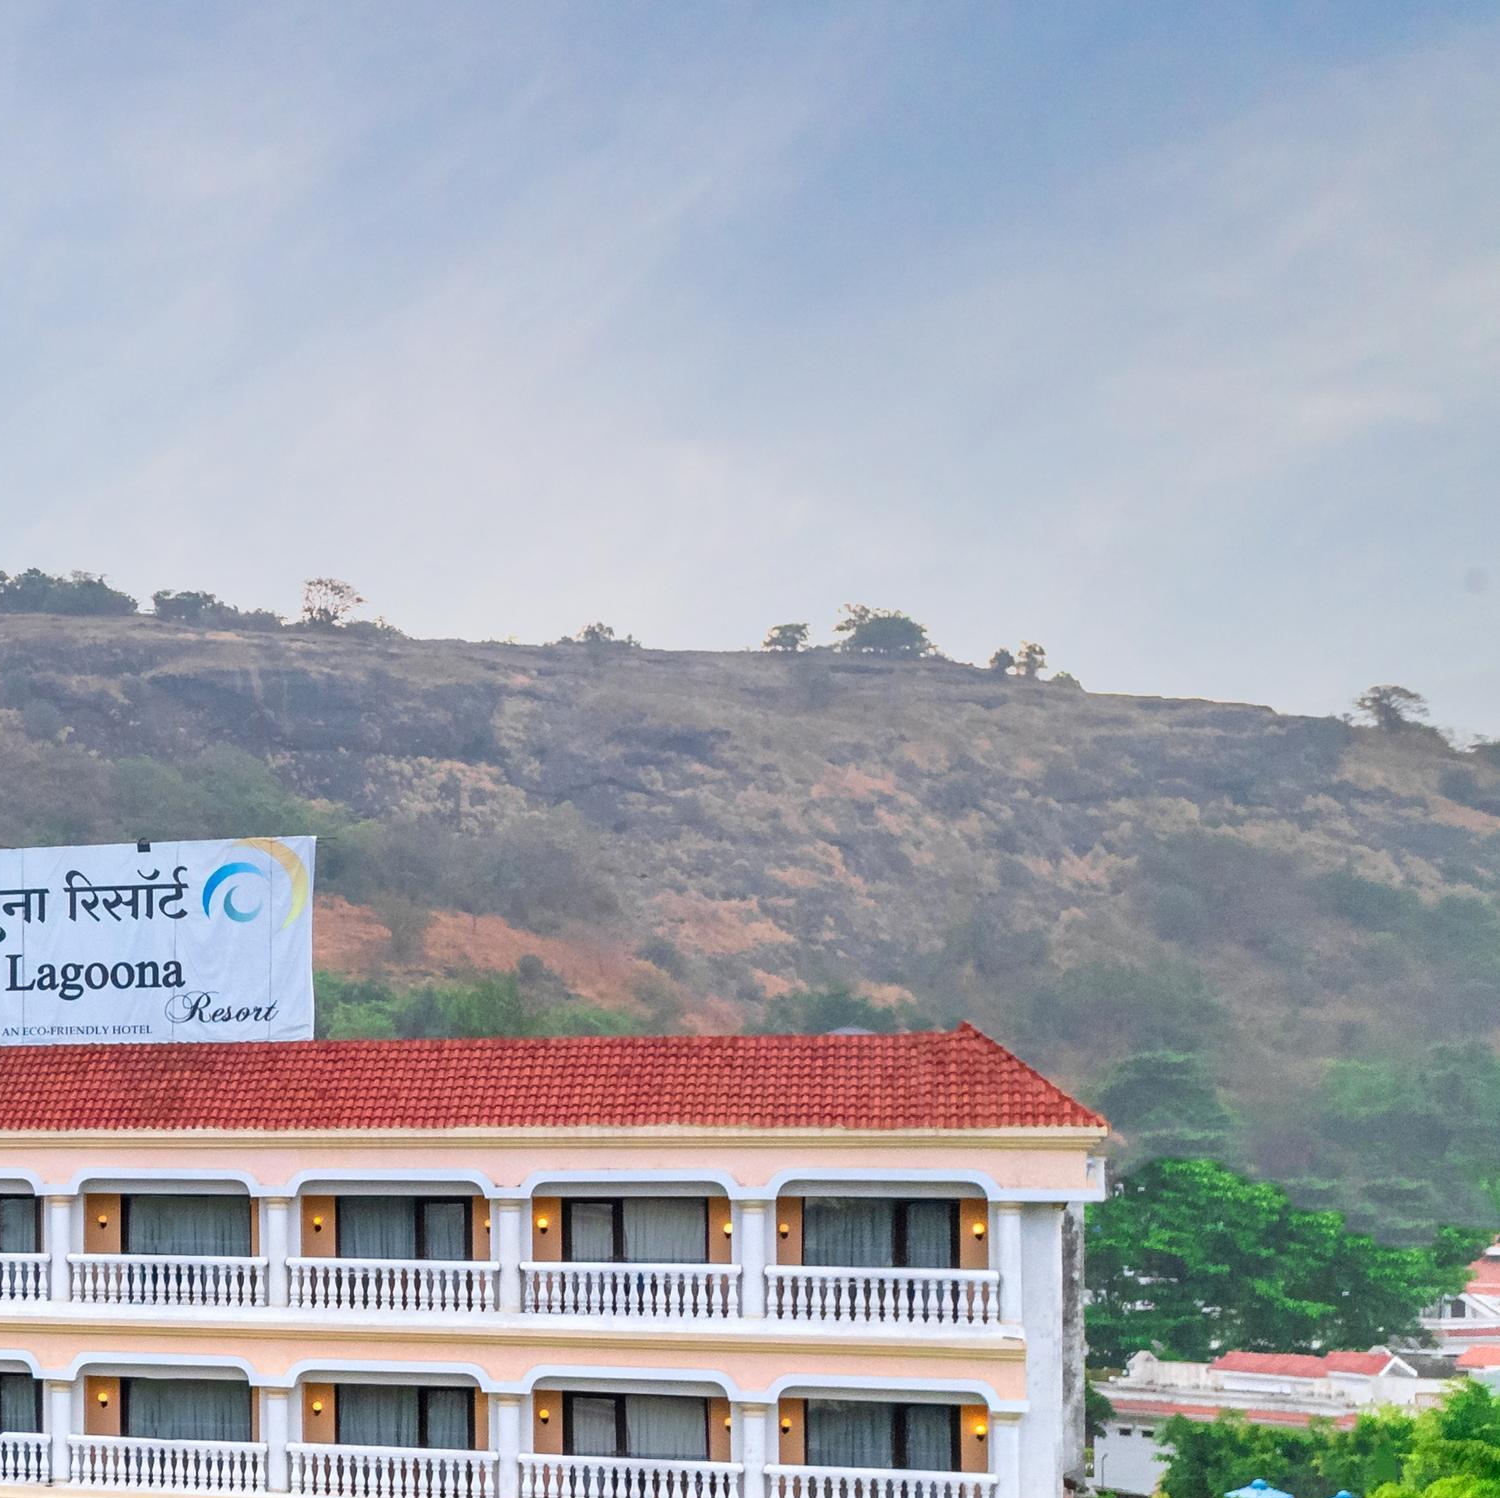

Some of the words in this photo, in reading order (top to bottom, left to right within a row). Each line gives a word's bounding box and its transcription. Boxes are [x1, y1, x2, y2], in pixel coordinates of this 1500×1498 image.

[63, 865, 190, 923] रिसॉर्ट
[4, 954, 187, 1001] Lagoona
[164, 990, 280, 1024] Resort
[1, 1026, 20, 1037] AN
[21, 1025, 111, 1036] ECO-FRIENDLY
[112, 1025, 152, 1035] HOTEL
